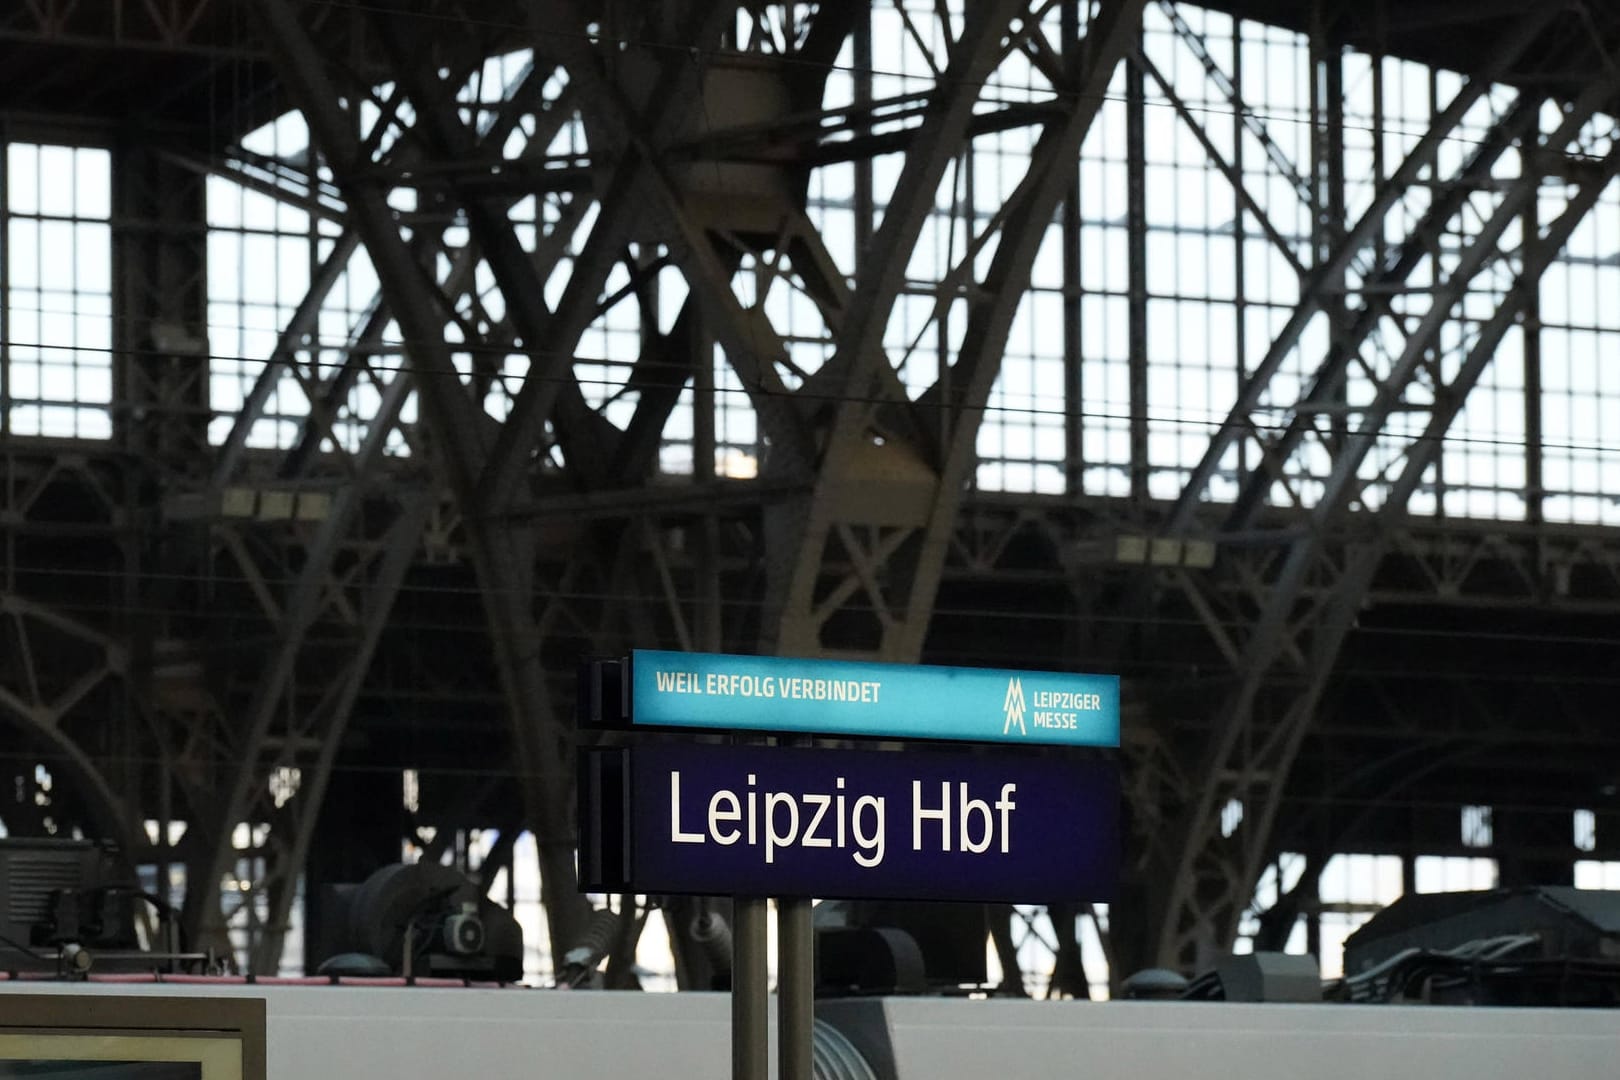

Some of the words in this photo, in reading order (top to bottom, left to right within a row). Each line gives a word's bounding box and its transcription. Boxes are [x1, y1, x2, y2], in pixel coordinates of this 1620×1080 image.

[656, 671, 703, 695] WEIL
[706, 673, 775, 698] ERFOLG
[778, 677, 881, 704] VERBINDET
[1033, 691, 1101, 711] LEIPZIGER
[1033, 711, 1078, 730] MESSE
[671, 771, 885, 868] Leipzig
[912, 780, 1017, 853] Hbf
